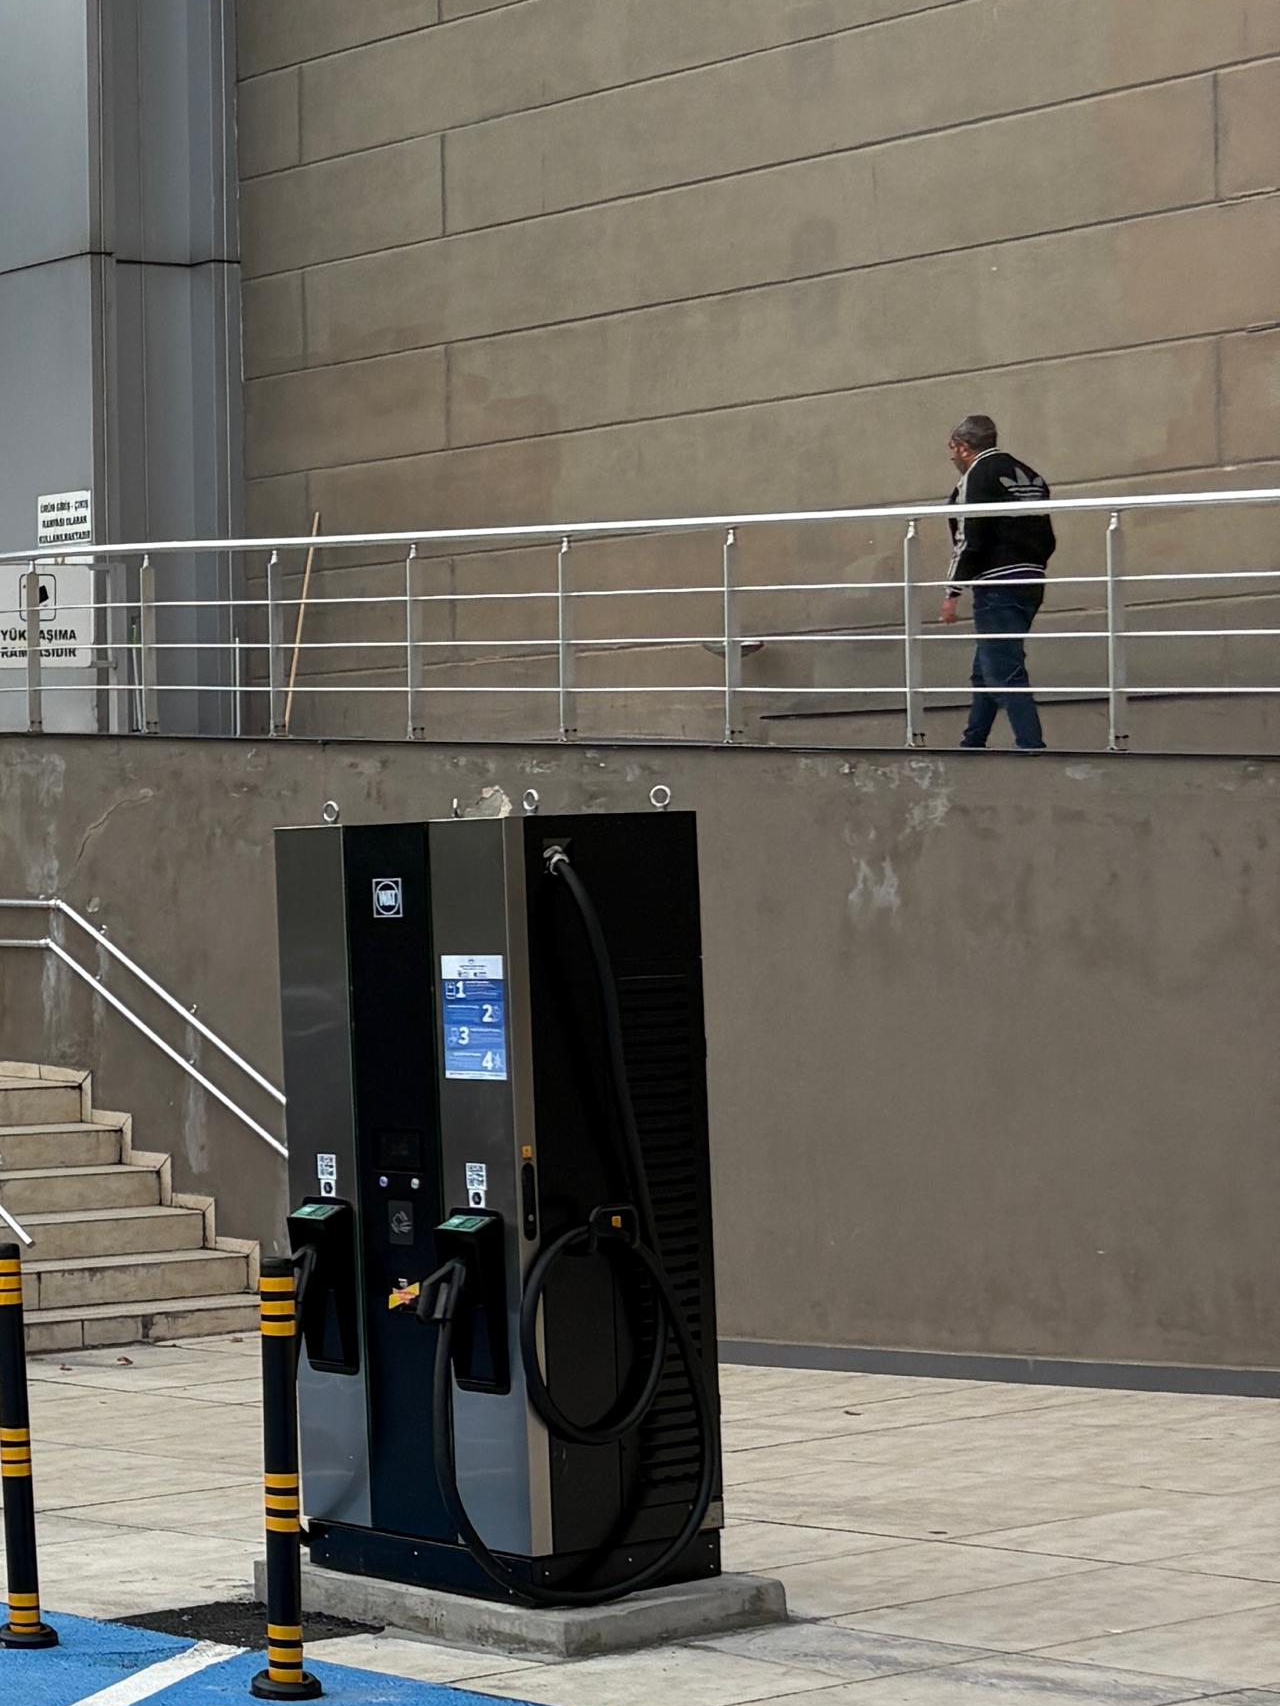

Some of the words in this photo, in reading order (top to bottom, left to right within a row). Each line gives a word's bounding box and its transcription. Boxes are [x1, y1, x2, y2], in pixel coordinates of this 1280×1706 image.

[0, 628, 28, 641] YÜK
[39, 629, 77, 643] AŞIMA
[456, 981, 466, 998] 1
[482, 1004, 493, 1022] 2
[458, 1026, 469, 1045] 3
[482, 1051, 494, 1070] 4
